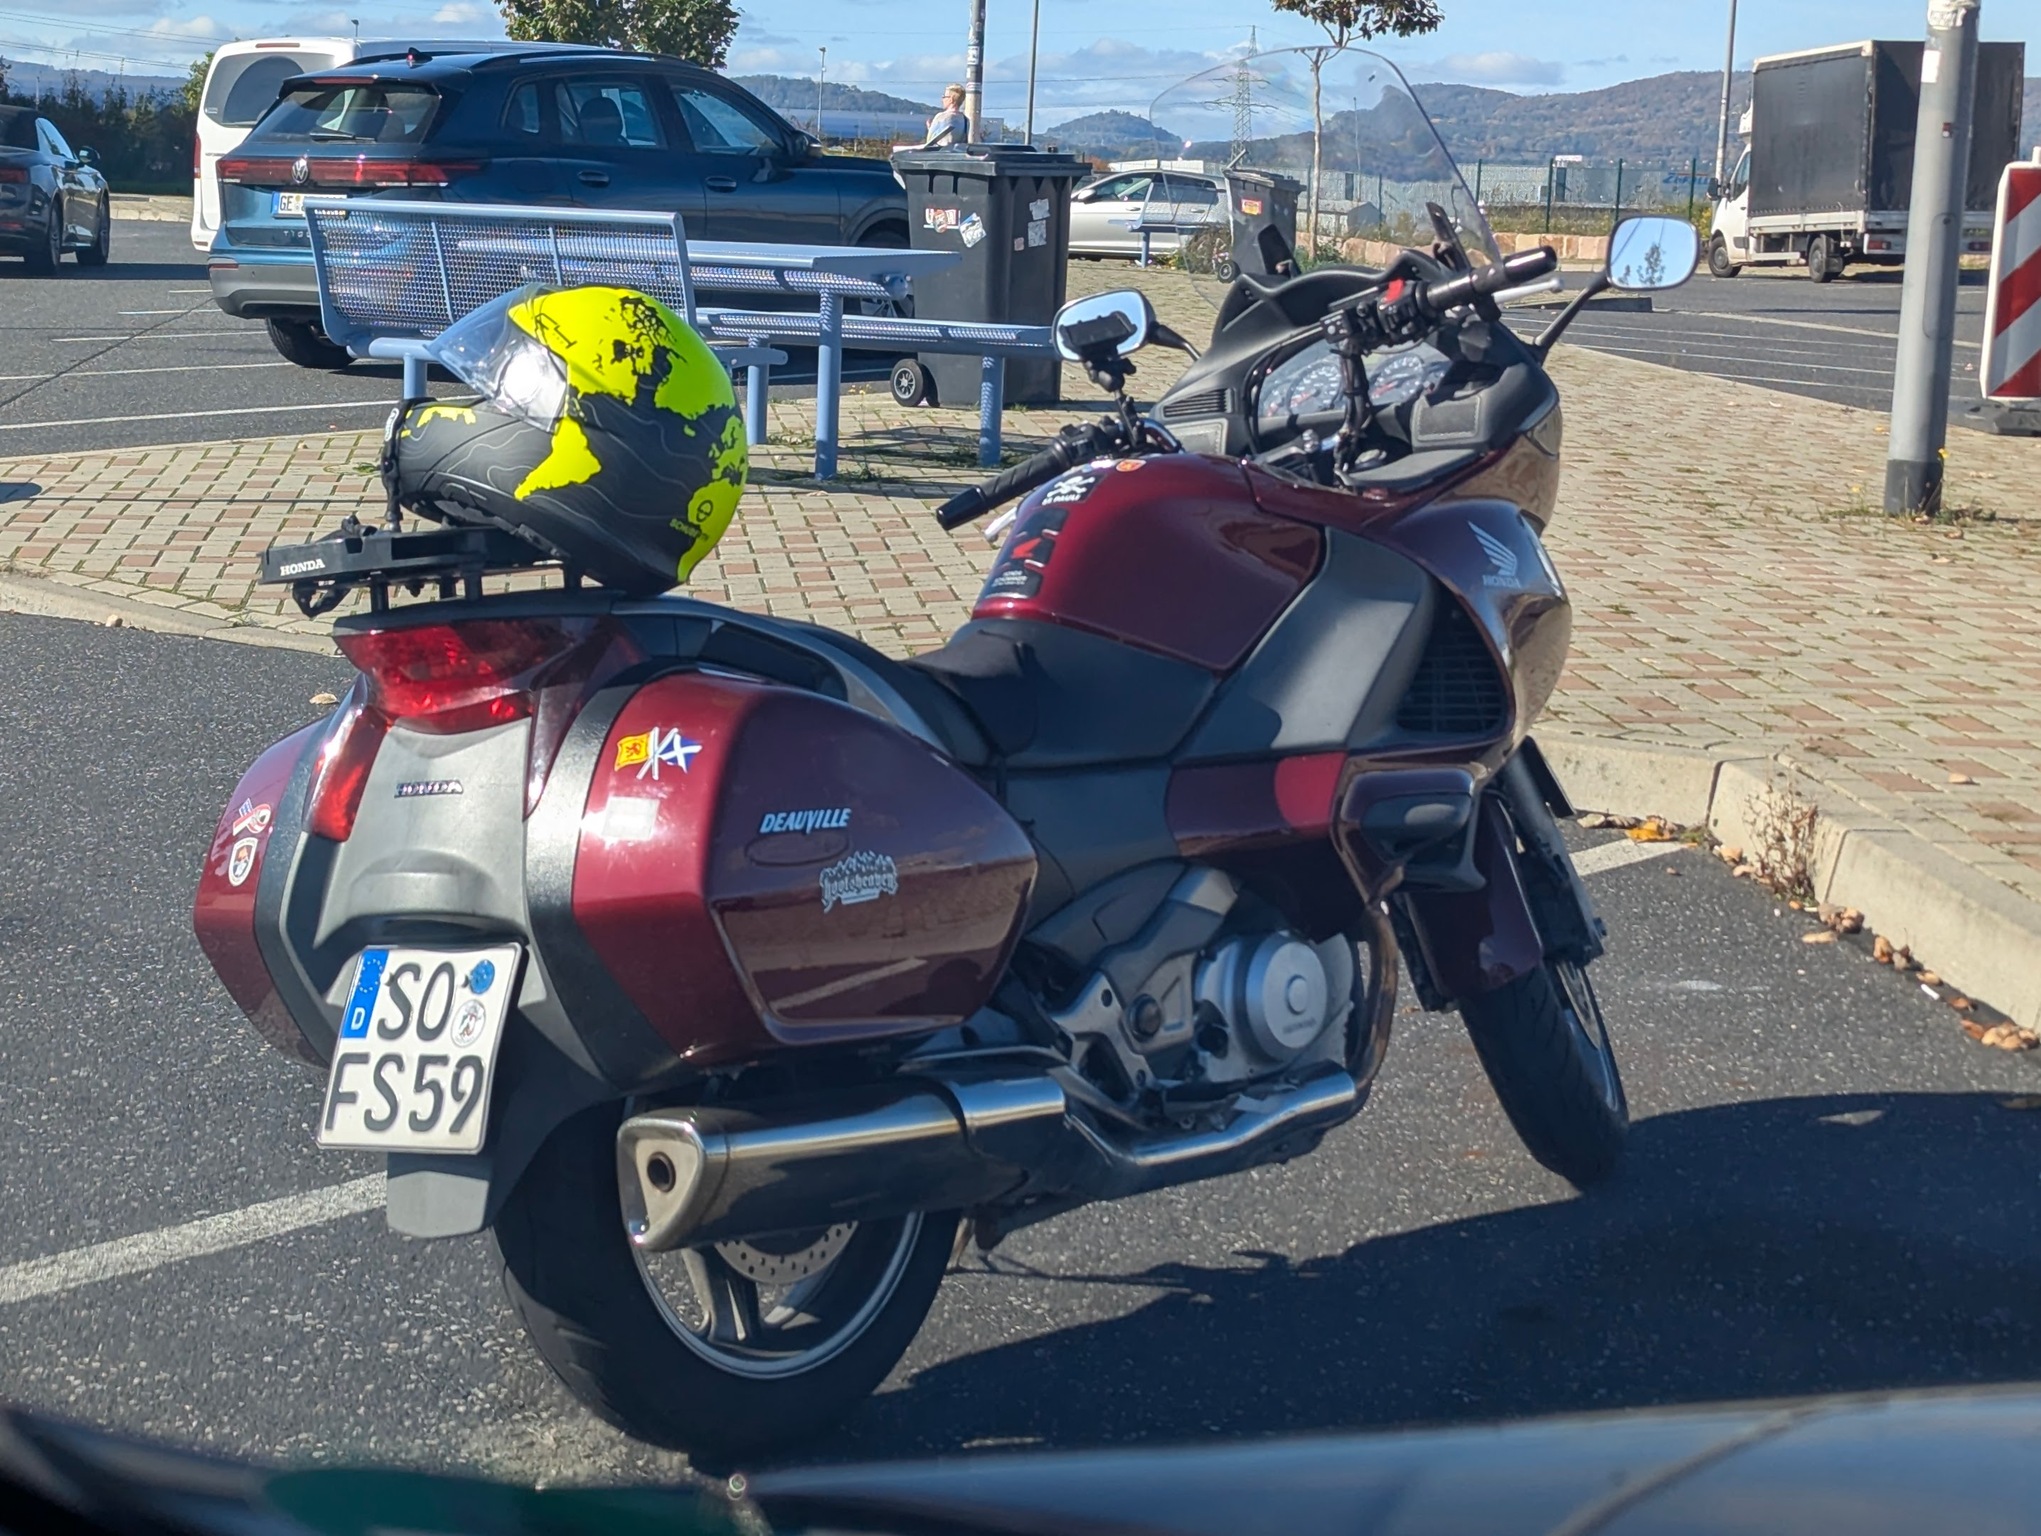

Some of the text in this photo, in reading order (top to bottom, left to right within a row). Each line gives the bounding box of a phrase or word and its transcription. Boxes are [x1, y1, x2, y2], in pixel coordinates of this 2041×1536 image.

[280, 195, 293, 211] GE
[280, 558, 326, 577] HONDA
[1482, 574, 1521, 589] HONDA
[759, 808, 852, 834] DEAUVILLE
[351, 961, 456, 1042] D SO
